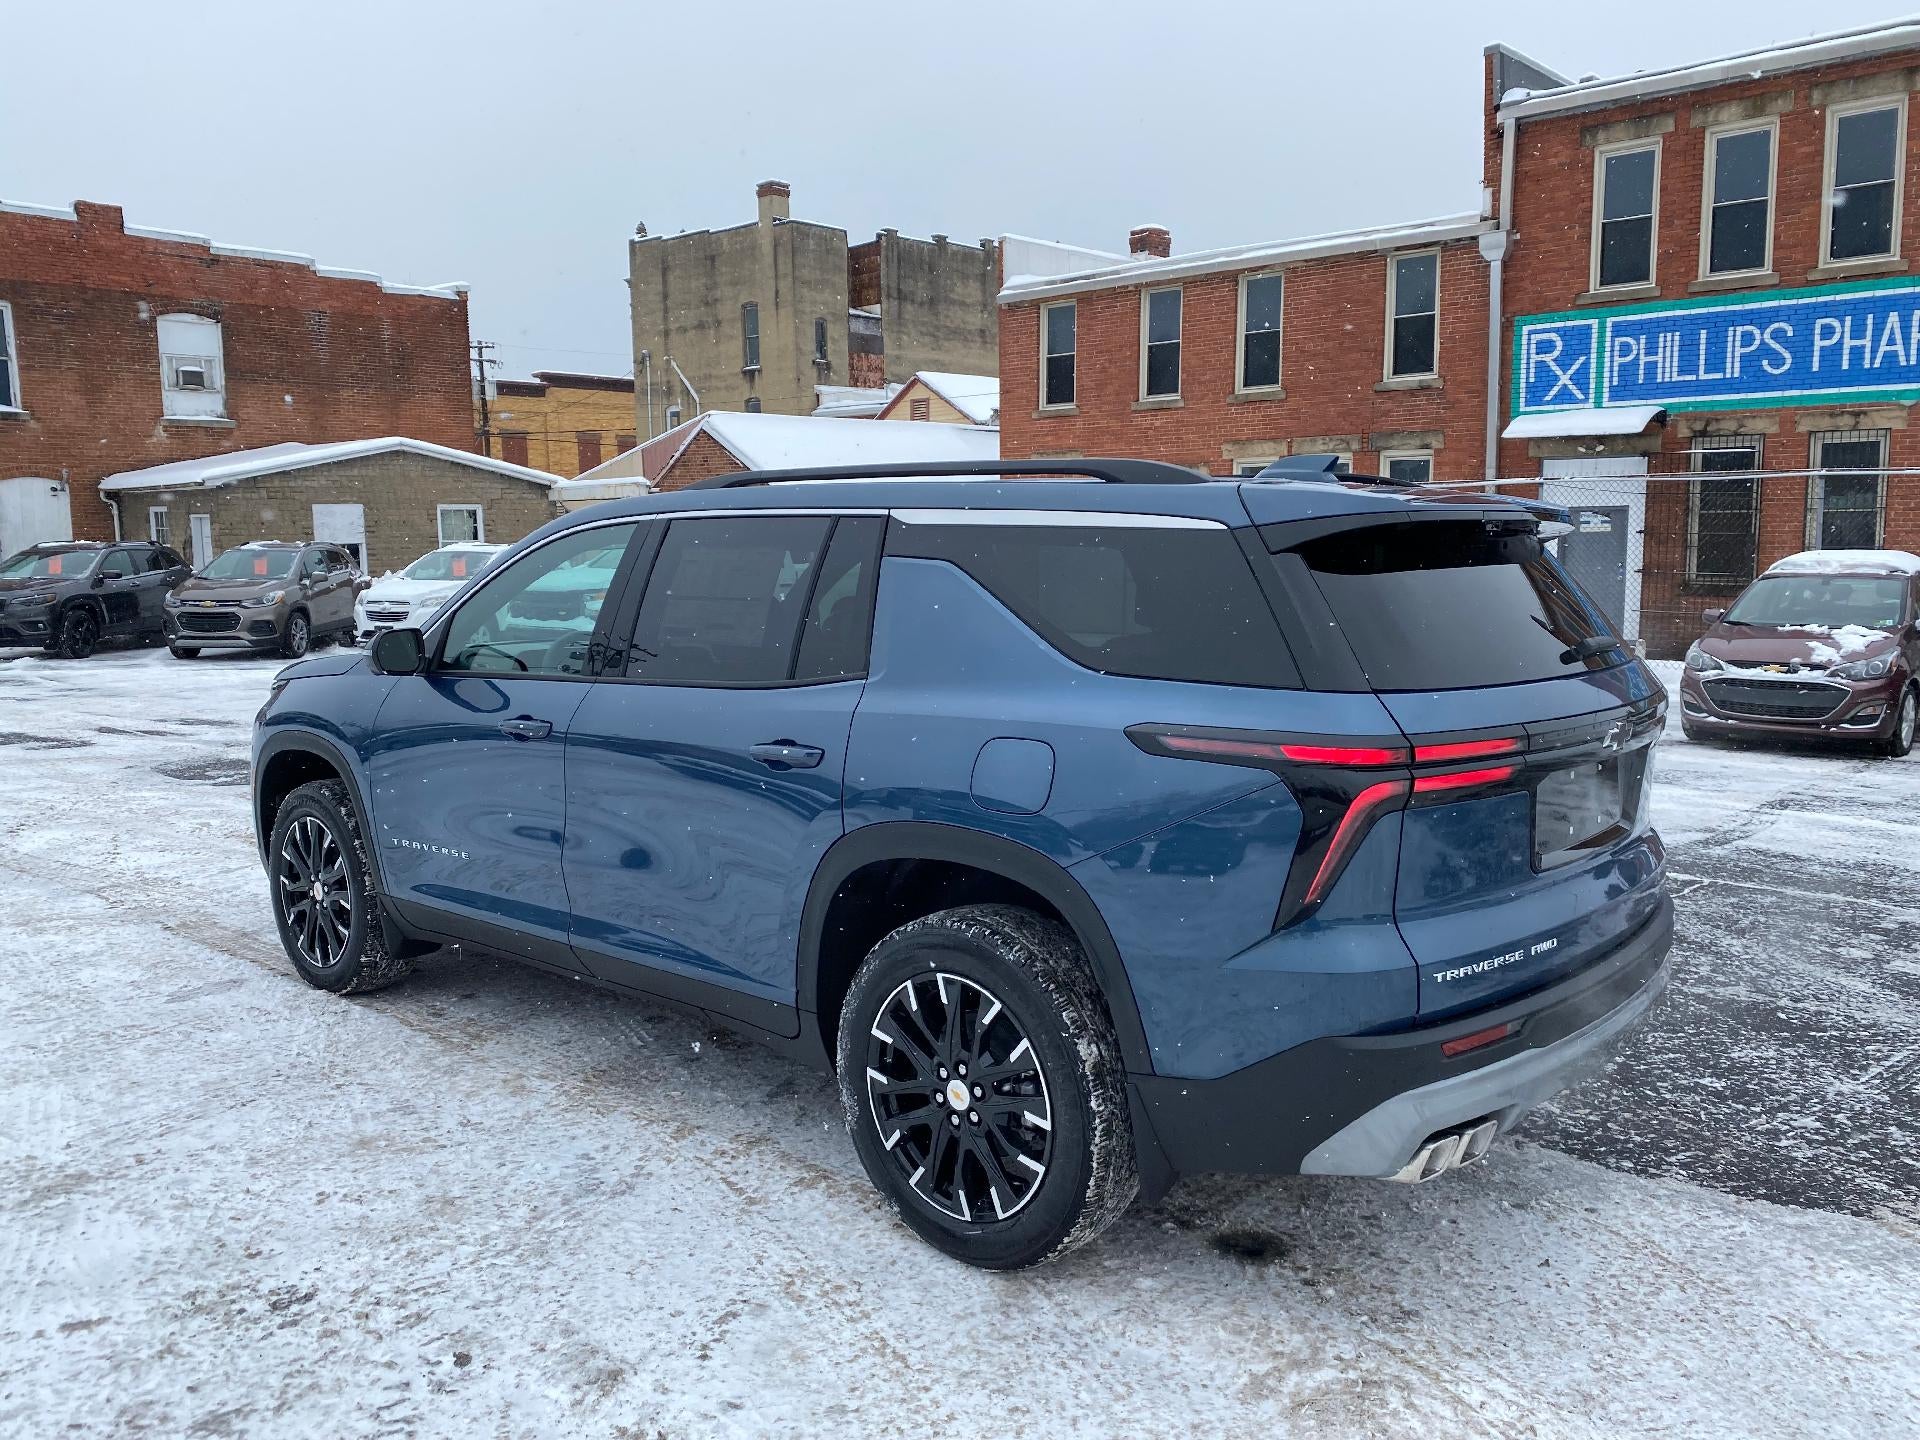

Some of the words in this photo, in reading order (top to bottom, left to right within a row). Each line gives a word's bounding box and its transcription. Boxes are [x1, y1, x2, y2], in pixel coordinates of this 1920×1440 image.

[1612, 321, 1794, 386] PHILLIPS
[391, 838, 469, 859] TRAVERSE
[1433, 949, 1524, 982] TRAVERSE
[1530, 937, 1558, 956] AWD
